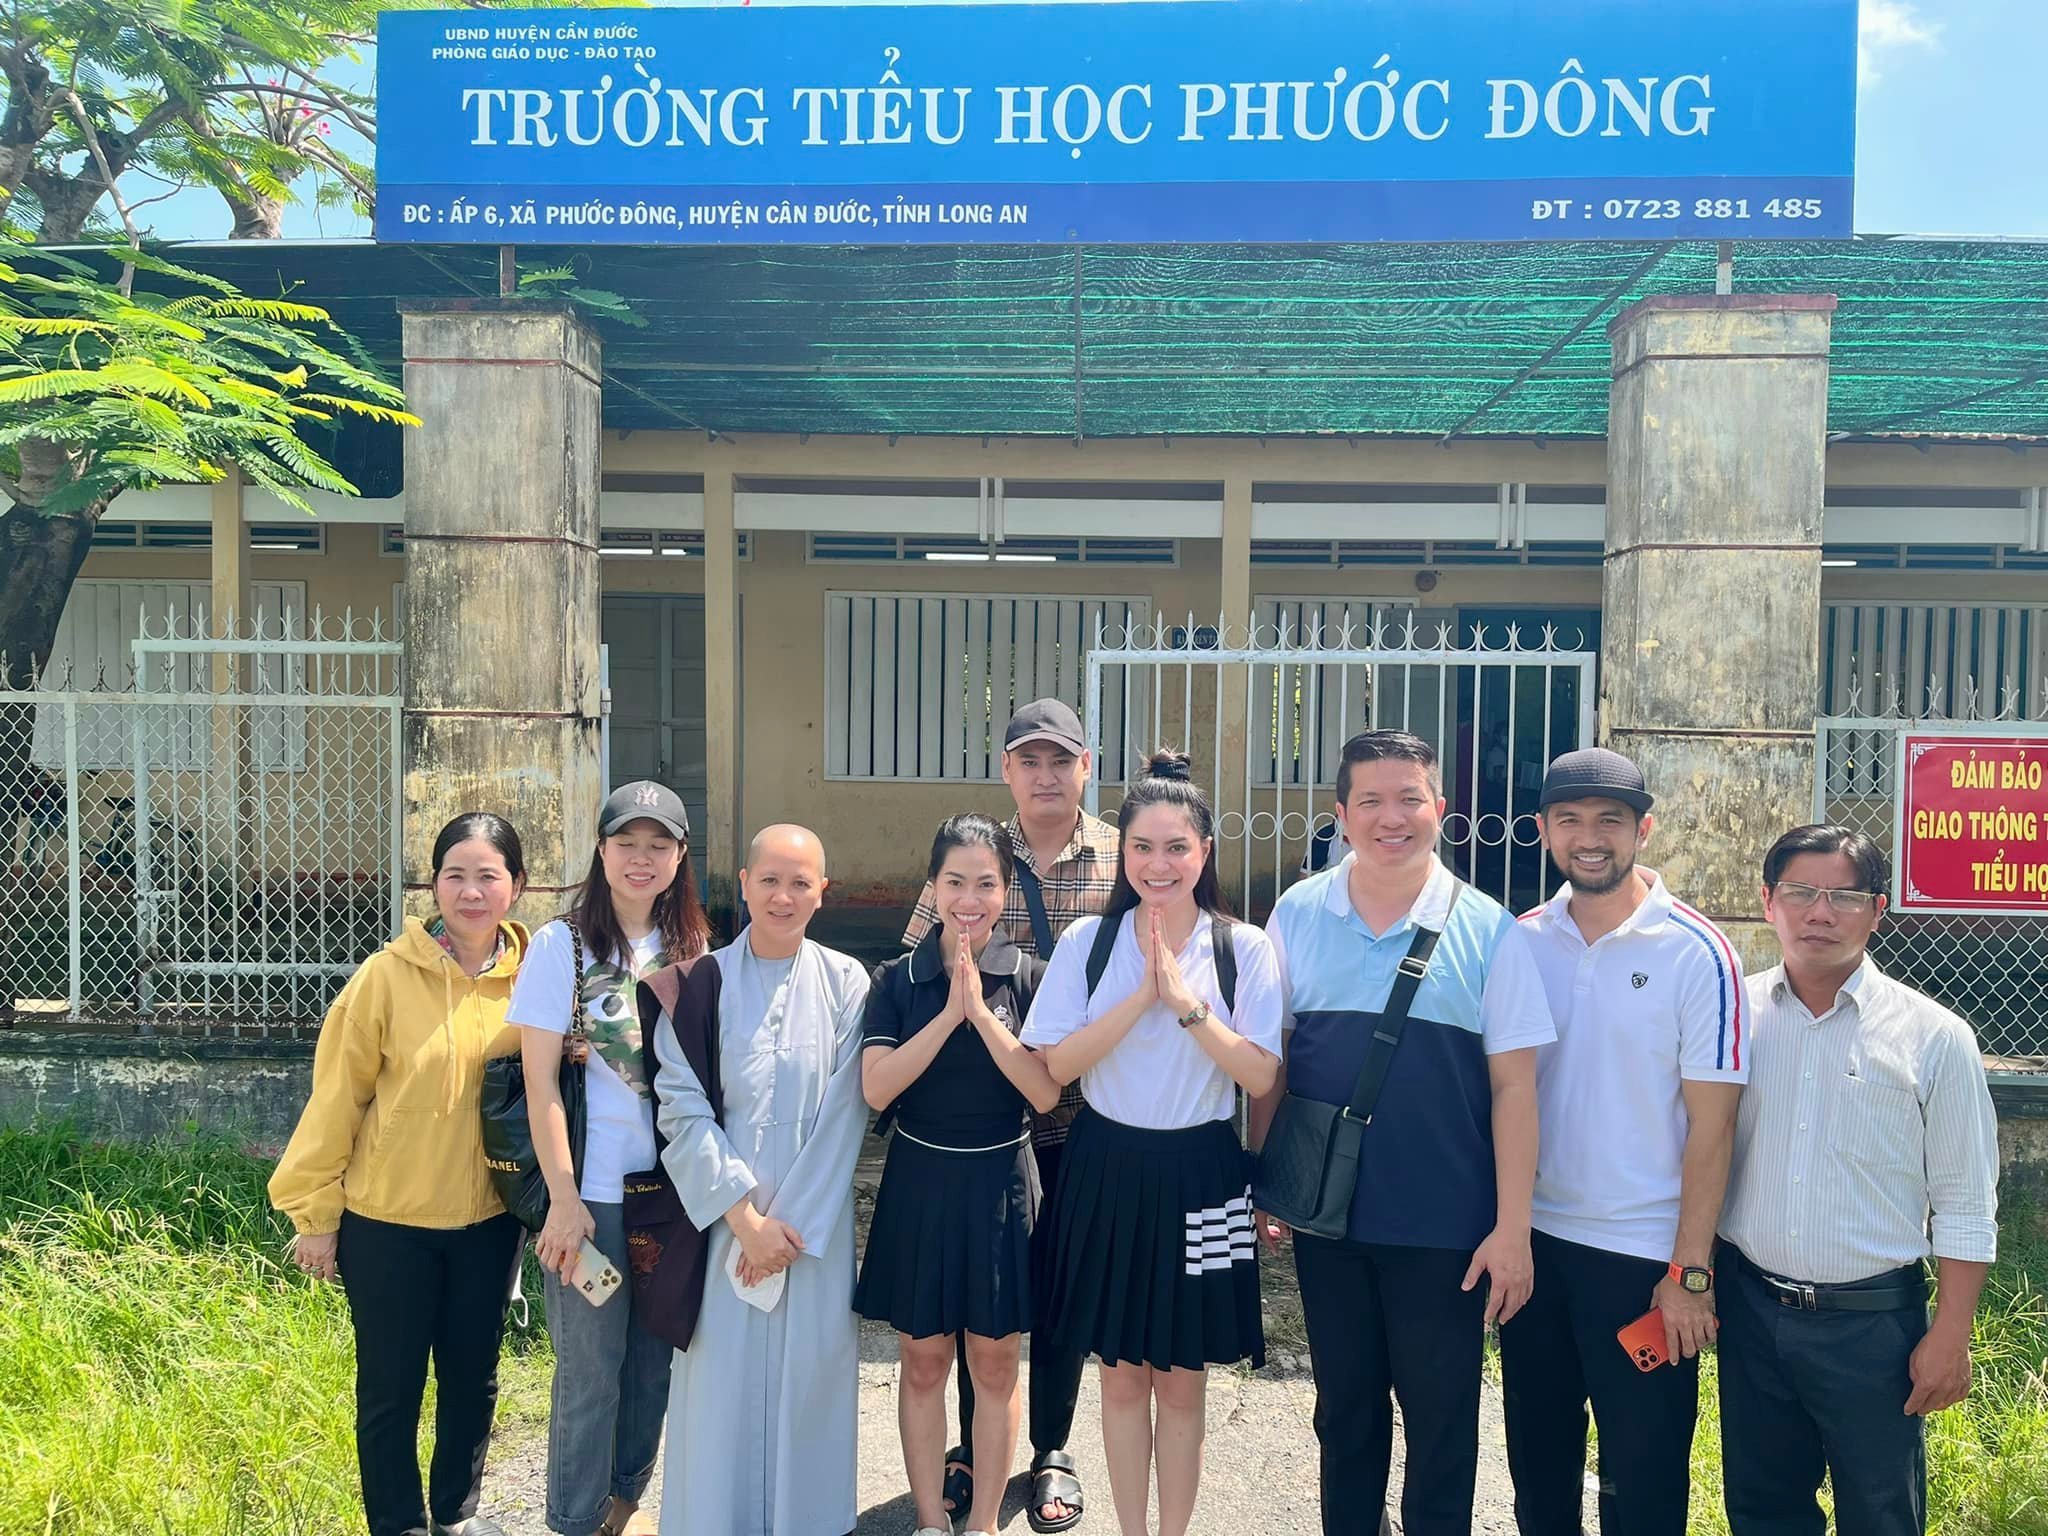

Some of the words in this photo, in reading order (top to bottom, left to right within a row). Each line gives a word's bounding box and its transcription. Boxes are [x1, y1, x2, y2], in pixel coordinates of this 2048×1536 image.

[445, 28, 490, 41] UBND
[495, 24, 550, 43] HUYỆN
[555, 21, 588, 40] CẦN
[593, 22, 638, 39] ĐƯỚC
[432, 44, 487, 59] PHÒNG
[491, 43, 530, 59] GIÁO
[535, 47, 569, 63] DỤC
[584, 43, 618, 59] ĐÀO
[623, 46, 657, 62] TẠO
[462, 57, 769, 147] TRƯỜNG
[792, 46, 972, 145] TIỂU
[994, 84, 1152, 159] HỌC
[1177, 53, 1449, 141] PHƯỚC
[1484, 58, 1715, 139] ĐÔNG
[403, 204, 431, 223] ĐC
[449, 196, 478, 224] ẤP
[509, 199, 537, 225] XÃ
[546, 198, 615, 225] PHƯỚC
[619, 200, 684, 231] ĐÔNG,
[689, 200, 759, 229] HUYỆN
[765, 200, 808, 224] CÂN
[813, 198, 879, 227] ĐƯỚC,
[882, 195, 931, 224] TỈNH
[938, 204, 993, 224] LONG
[998, 204, 1028, 224] AN
[1531, 199, 1573, 220] ĐT
[1603, 199, 1681, 219] 0723
[1694, 198, 1751, 219] 881
[1762, 198, 1822, 219] 485
[1950, 749, 1996, 789] ĐẢM
[2001, 750, 2042, 791] BẢO
[1913, 810, 1963, 840] GIAO
[1968, 805, 2037, 842] THÔNG
[1971, 848, 2018, 892] TIỂU
